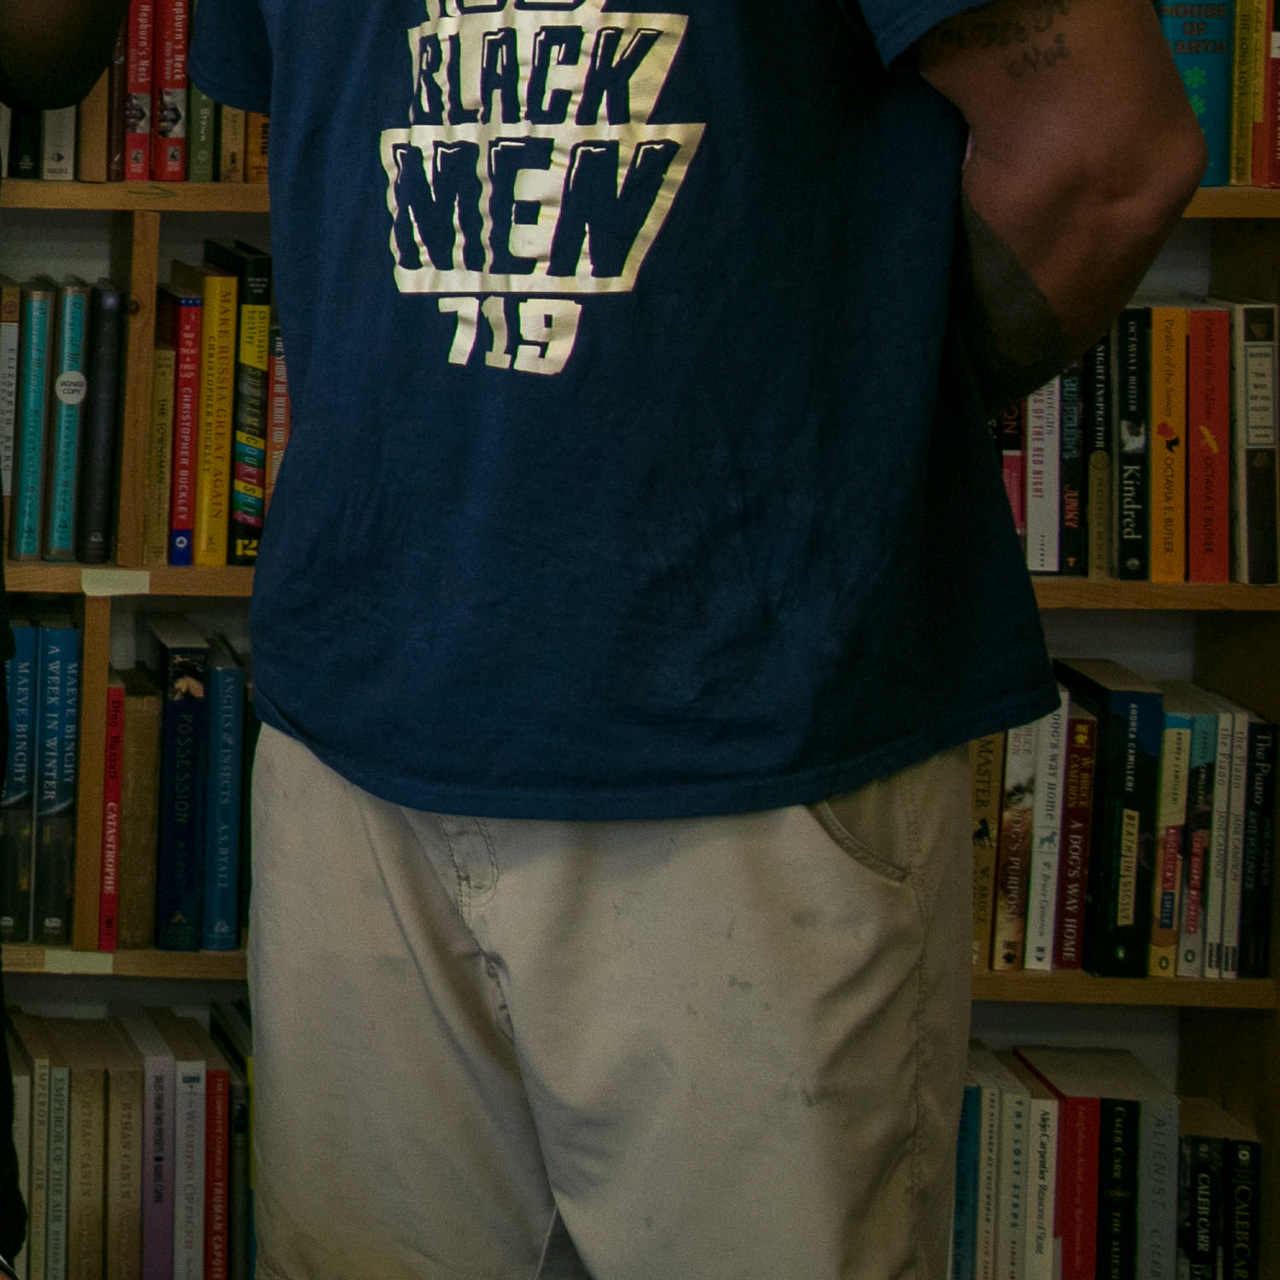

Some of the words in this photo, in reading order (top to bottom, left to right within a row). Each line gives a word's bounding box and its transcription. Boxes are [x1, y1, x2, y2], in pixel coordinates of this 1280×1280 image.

[173, 53, 186, 81] Neck
[412, 19, 679, 127] BLACK
[389, 131, 695, 284] MEN
[438, 295, 583, 376] 719
[179, 387, 192, 467] CHRISTOPHER
[177, 470, 189, 520] BUCKLEY
[1123, 465, 1142, 540] Kindred
[17, 661, 29, 716] MAEVE
[66, 662, 78, 718] MAEVE
[13, 723, 28, 785] BINCHY
[43, 736, 59, 801] WINTER
[65, 724, 76, 784] BINCHY
[104, 802, 116, 895] CATASTROPHE
[1197, 1173, 1211, 1217] CALEB
[1197, 1220, 1210, 1252] CARR
